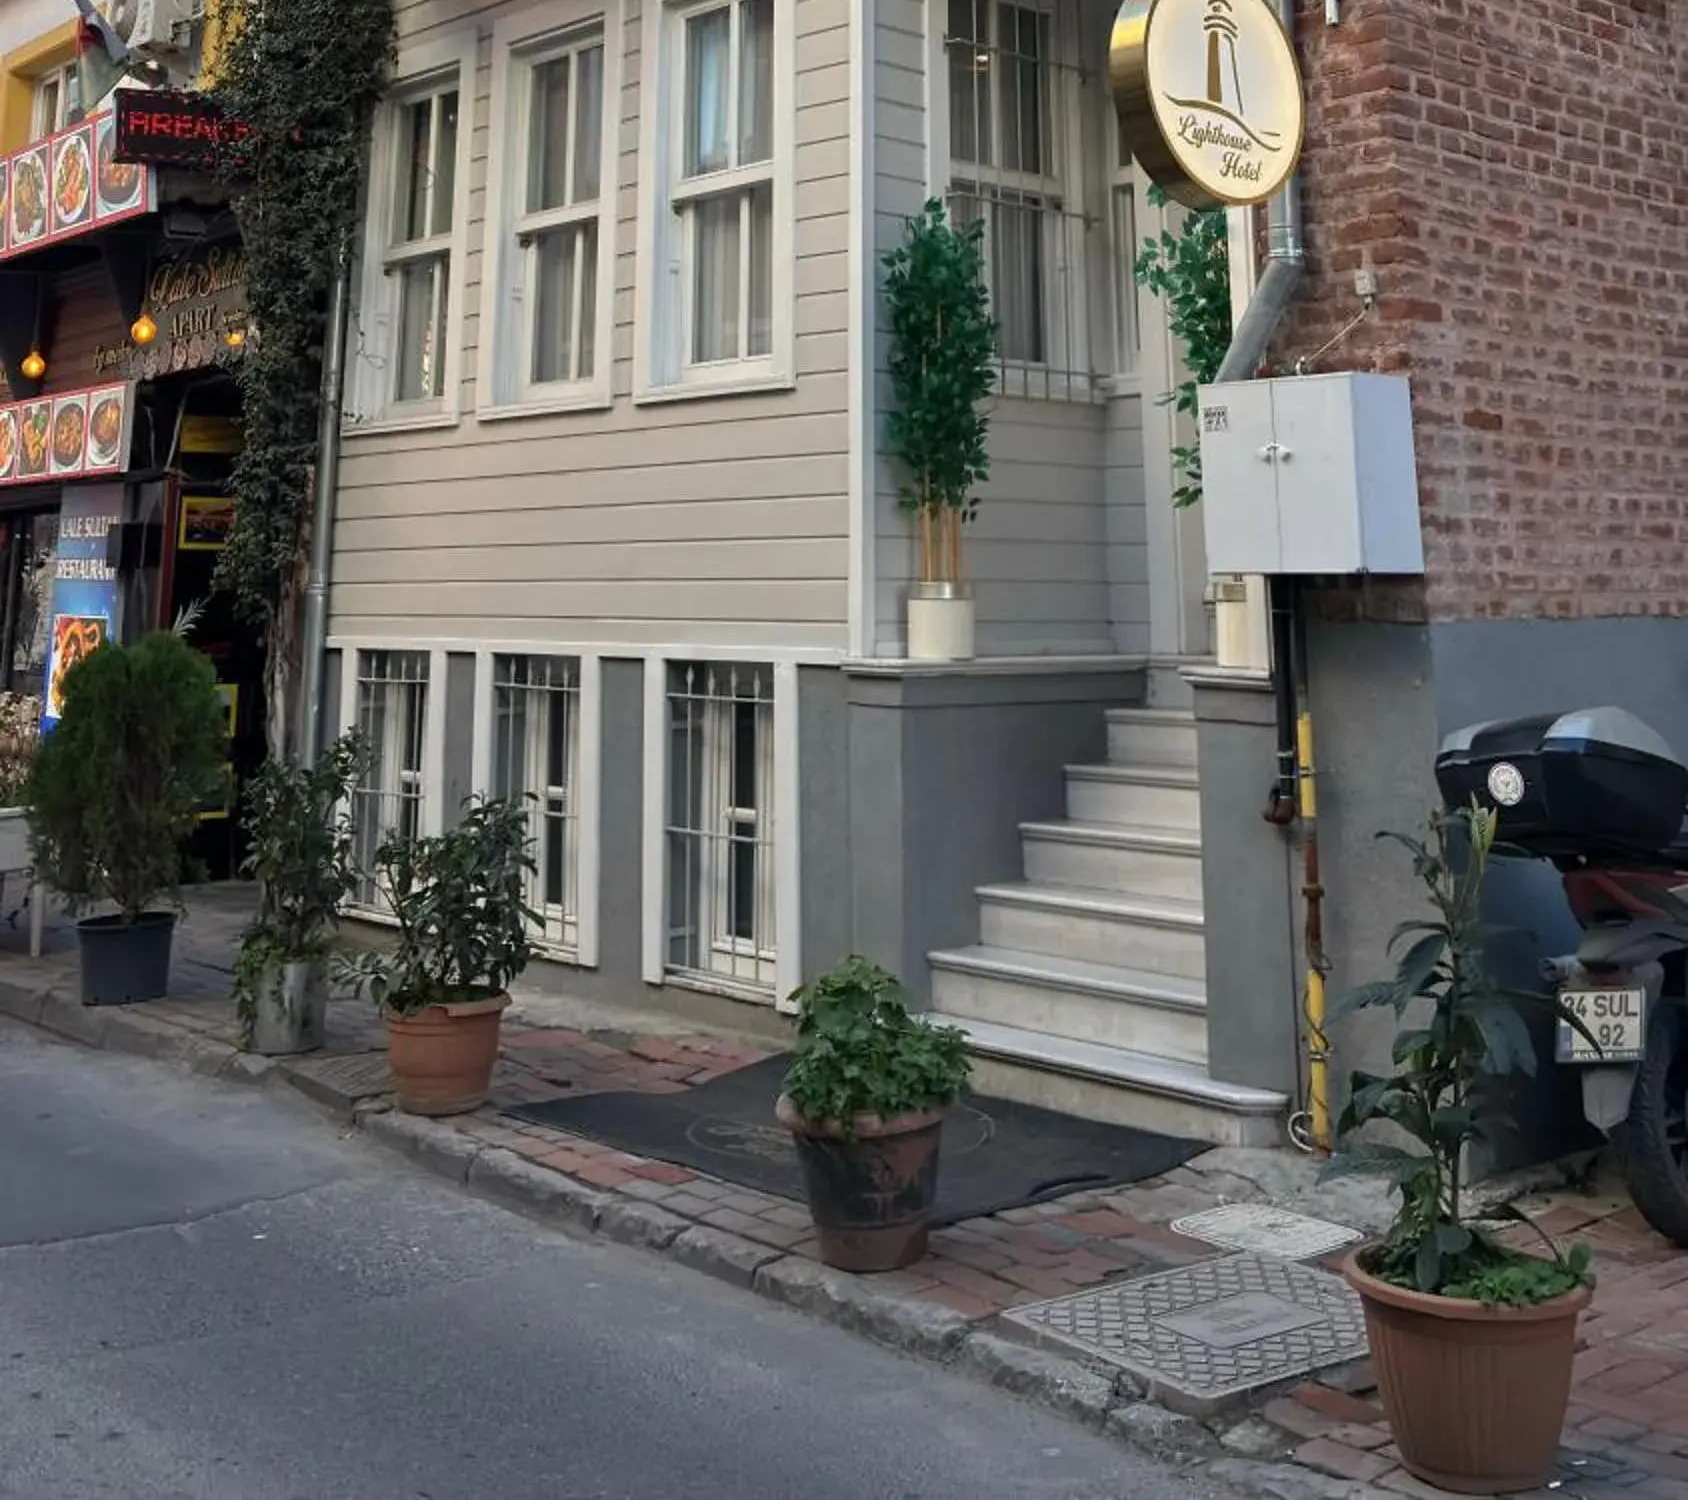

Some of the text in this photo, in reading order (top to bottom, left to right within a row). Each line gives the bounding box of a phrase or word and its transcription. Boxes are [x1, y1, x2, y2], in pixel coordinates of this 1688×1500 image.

[1178, 113, 1252, 152] Lighthouse
[1219, 151, 1263, 183] Hotel
[1593, 993, 1638, 1018] SUL
[1599, 1023, 1624, 1047] 92
